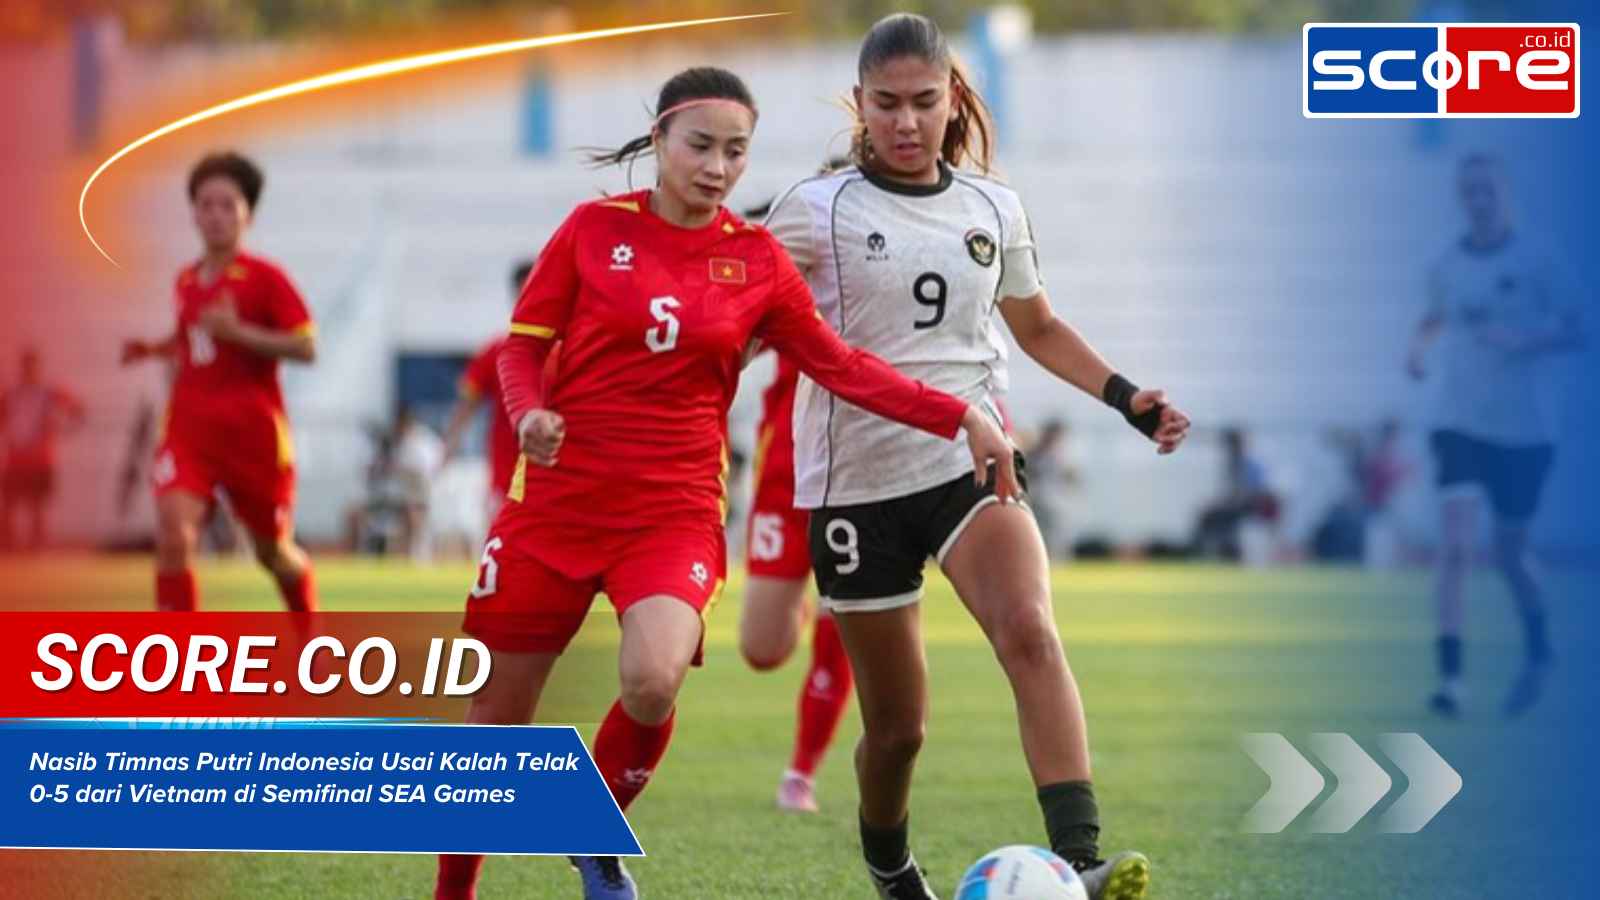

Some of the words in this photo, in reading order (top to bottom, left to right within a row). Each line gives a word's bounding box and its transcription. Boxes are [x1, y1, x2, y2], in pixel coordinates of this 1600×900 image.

[645, 295, 681, 353] 5
[913, 271, 947, 330] 9
[825, 518, 860, 575] 9
